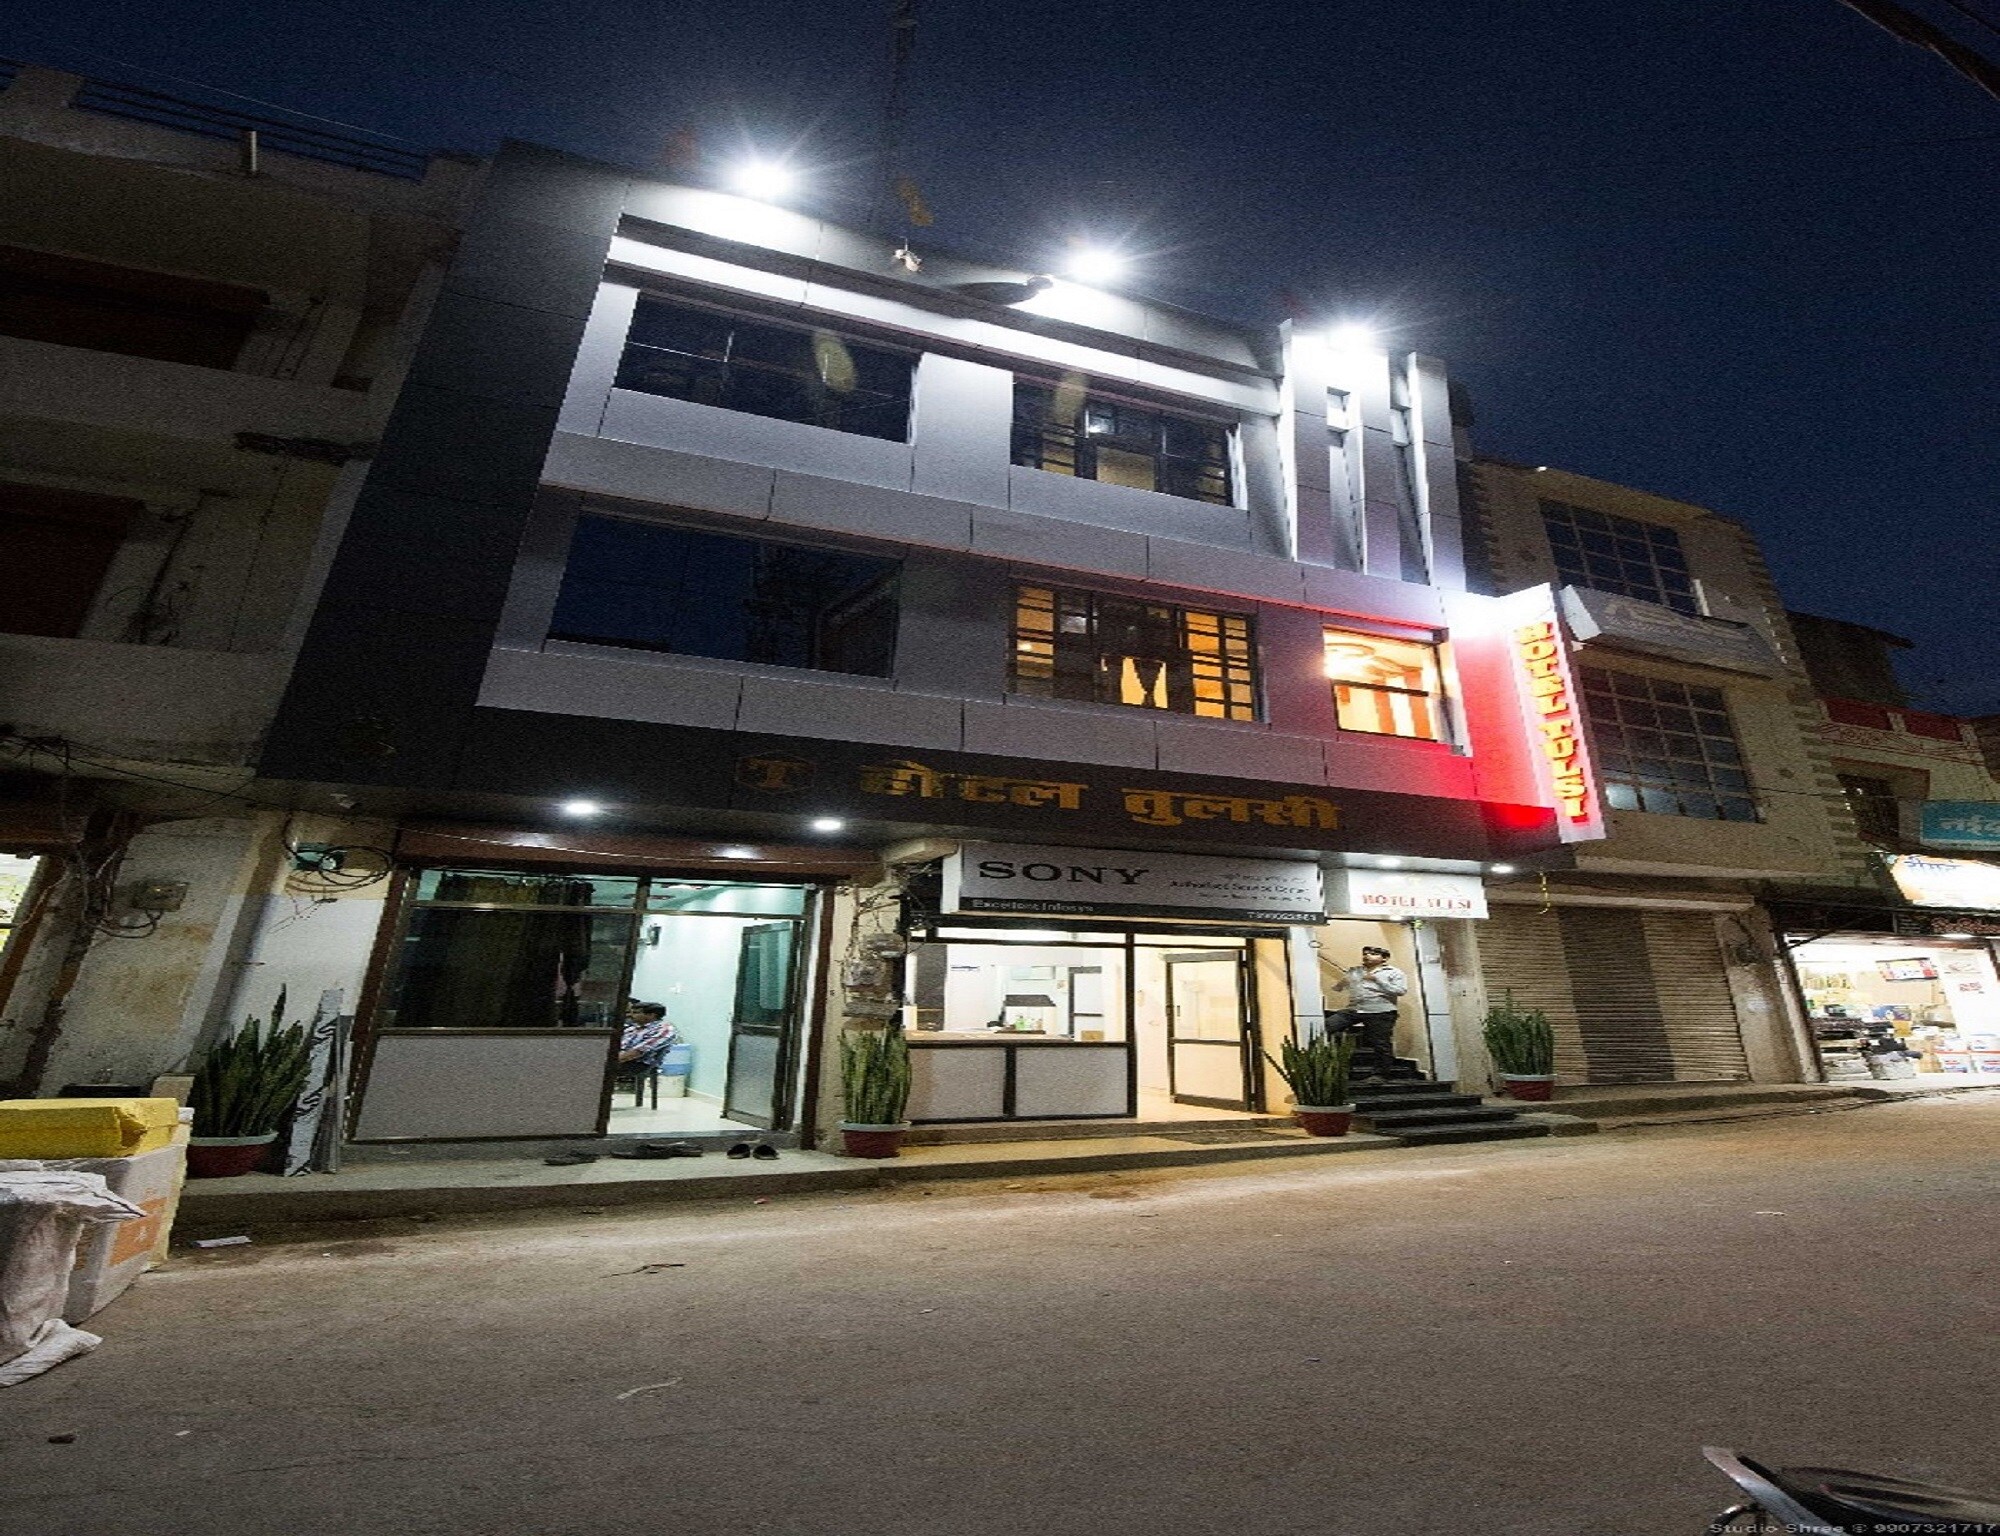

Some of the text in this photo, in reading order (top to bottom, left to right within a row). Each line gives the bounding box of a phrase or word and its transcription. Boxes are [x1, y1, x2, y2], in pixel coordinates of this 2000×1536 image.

[1516, 622, 1588, 822] HOTEL TULSI
[1121, 787, 1342, 830] तुलसी
[979, 860, 1150, 885] SONY
